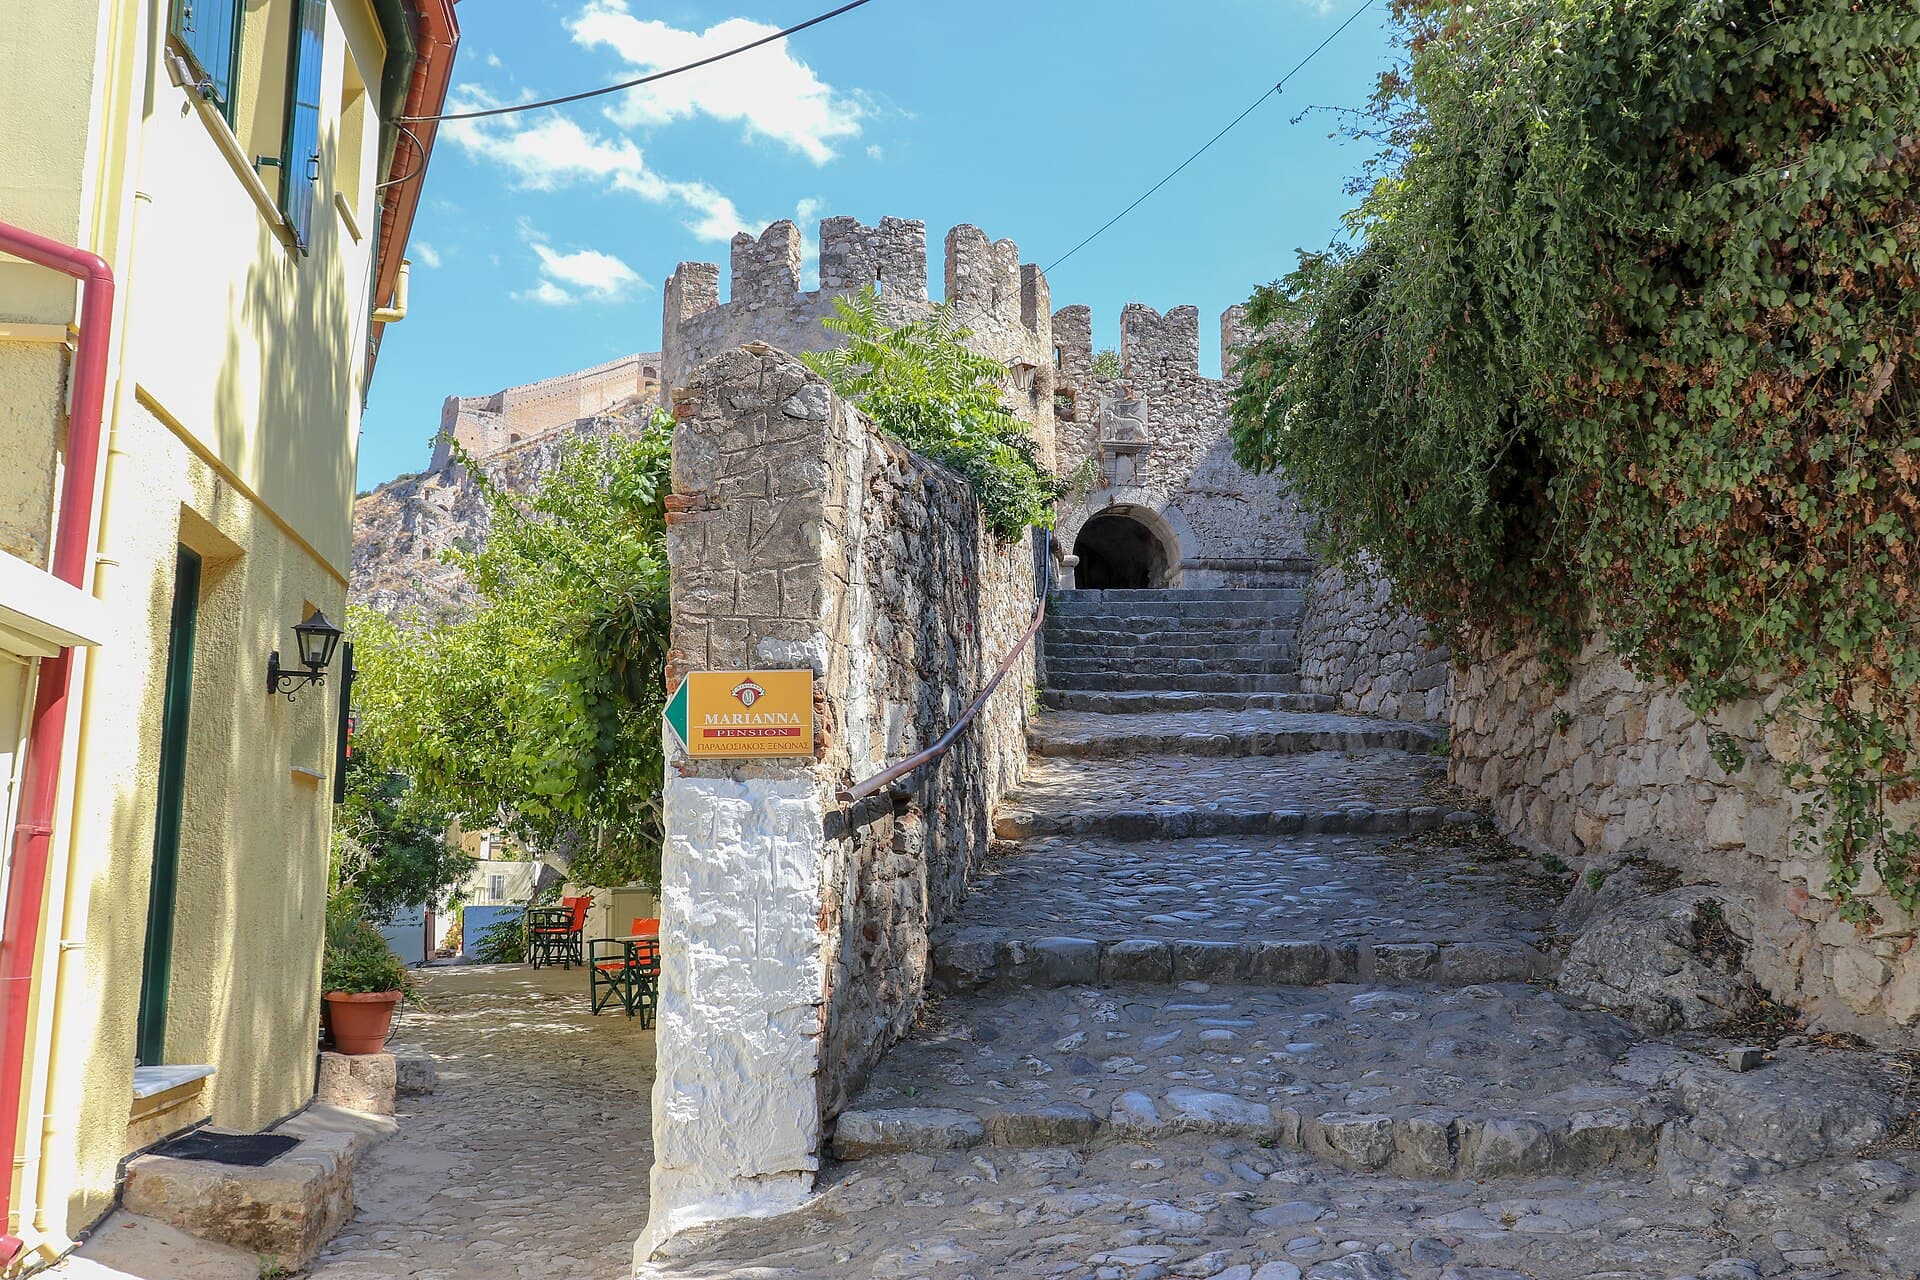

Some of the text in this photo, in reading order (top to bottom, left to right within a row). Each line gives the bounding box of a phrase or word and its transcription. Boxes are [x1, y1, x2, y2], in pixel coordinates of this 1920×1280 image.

[704, 713, 801, 725] MARIANNA
[717, 728, 789, 737] PENSION
[697, 741, 809, 751] ΠΑΡΑΔΟΣΙΑΚΟΣ ΞΕΝΩΝΑΣ
